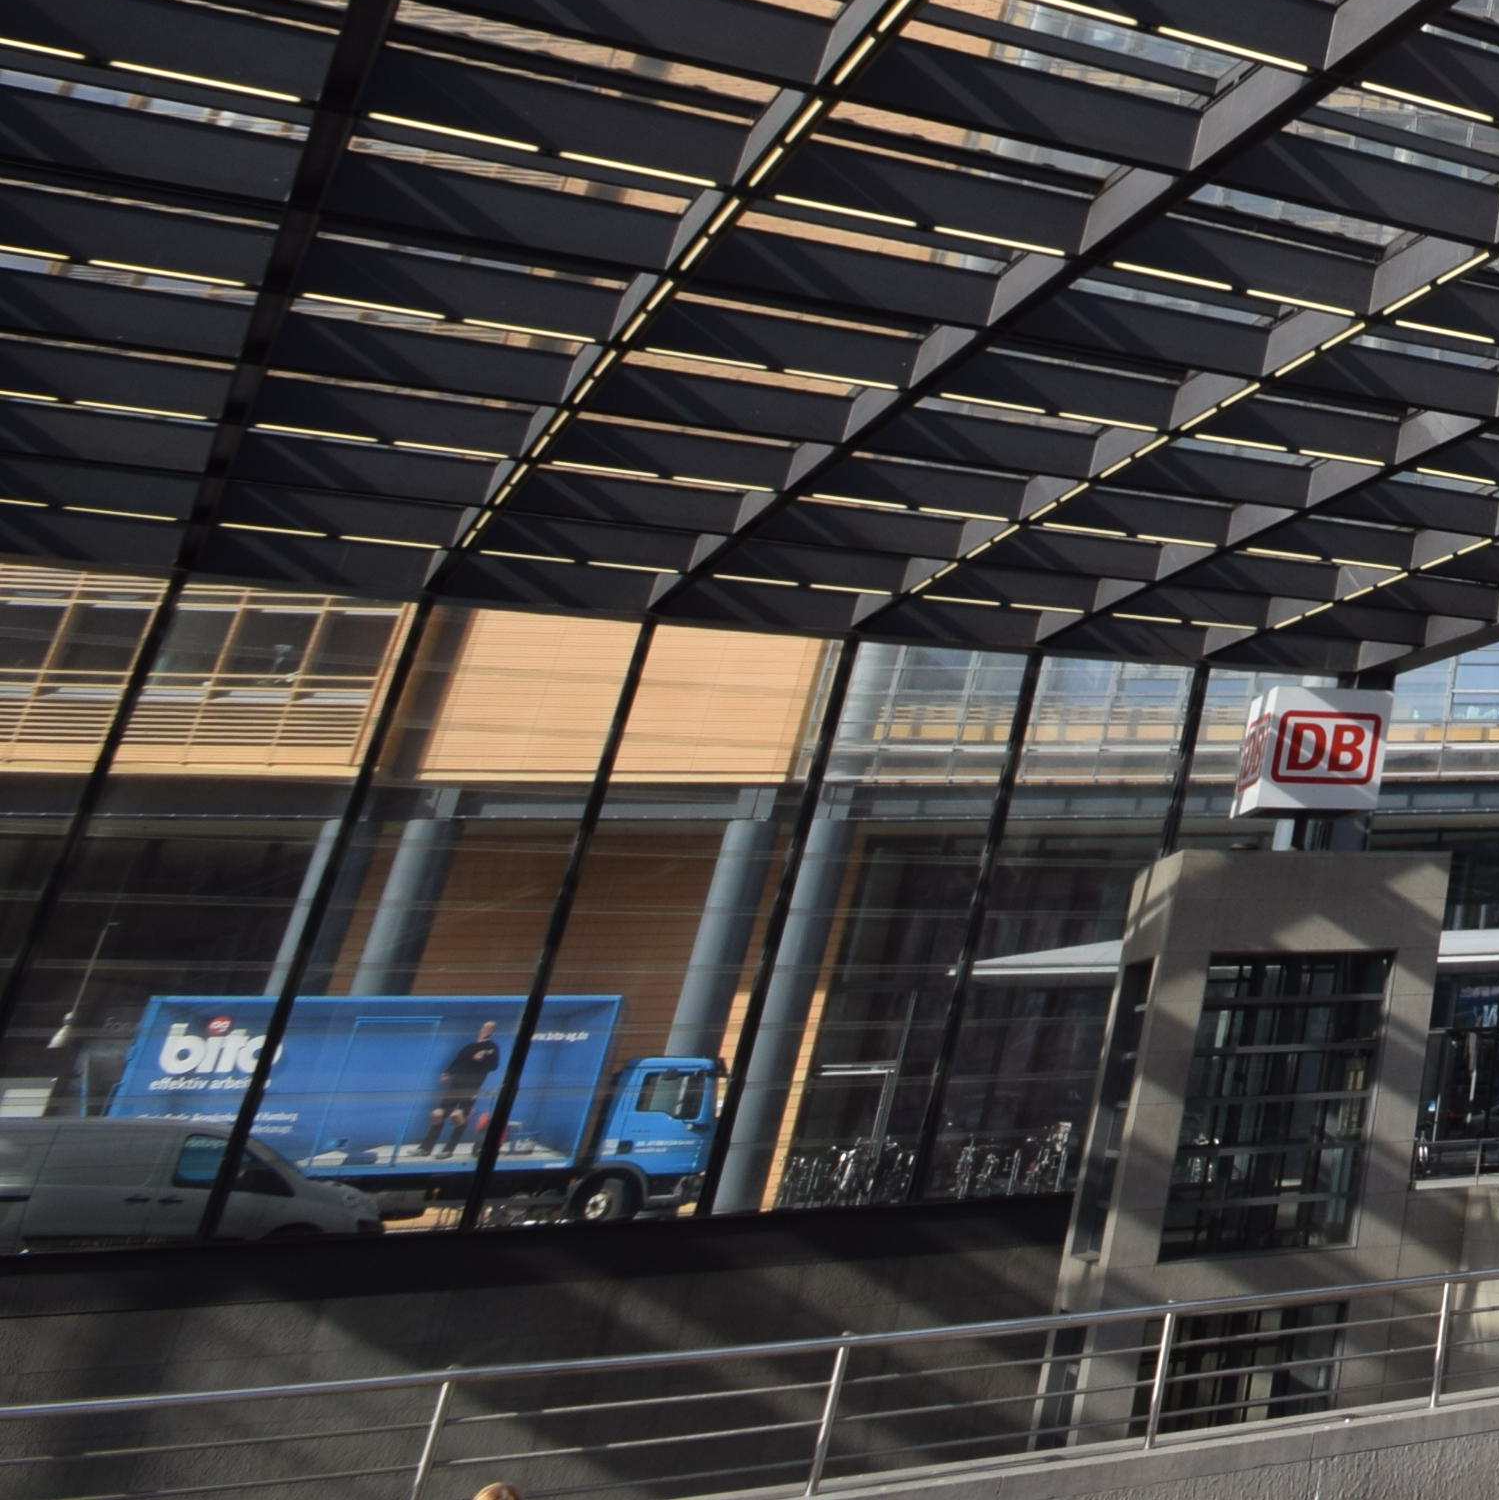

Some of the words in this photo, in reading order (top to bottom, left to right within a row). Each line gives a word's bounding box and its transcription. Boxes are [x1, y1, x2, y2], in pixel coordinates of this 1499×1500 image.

[1285, 721, 1366, 773] DB
[158, 1022, 283, 1075] bito
[148, 1076, 209, 1091] effektiv
